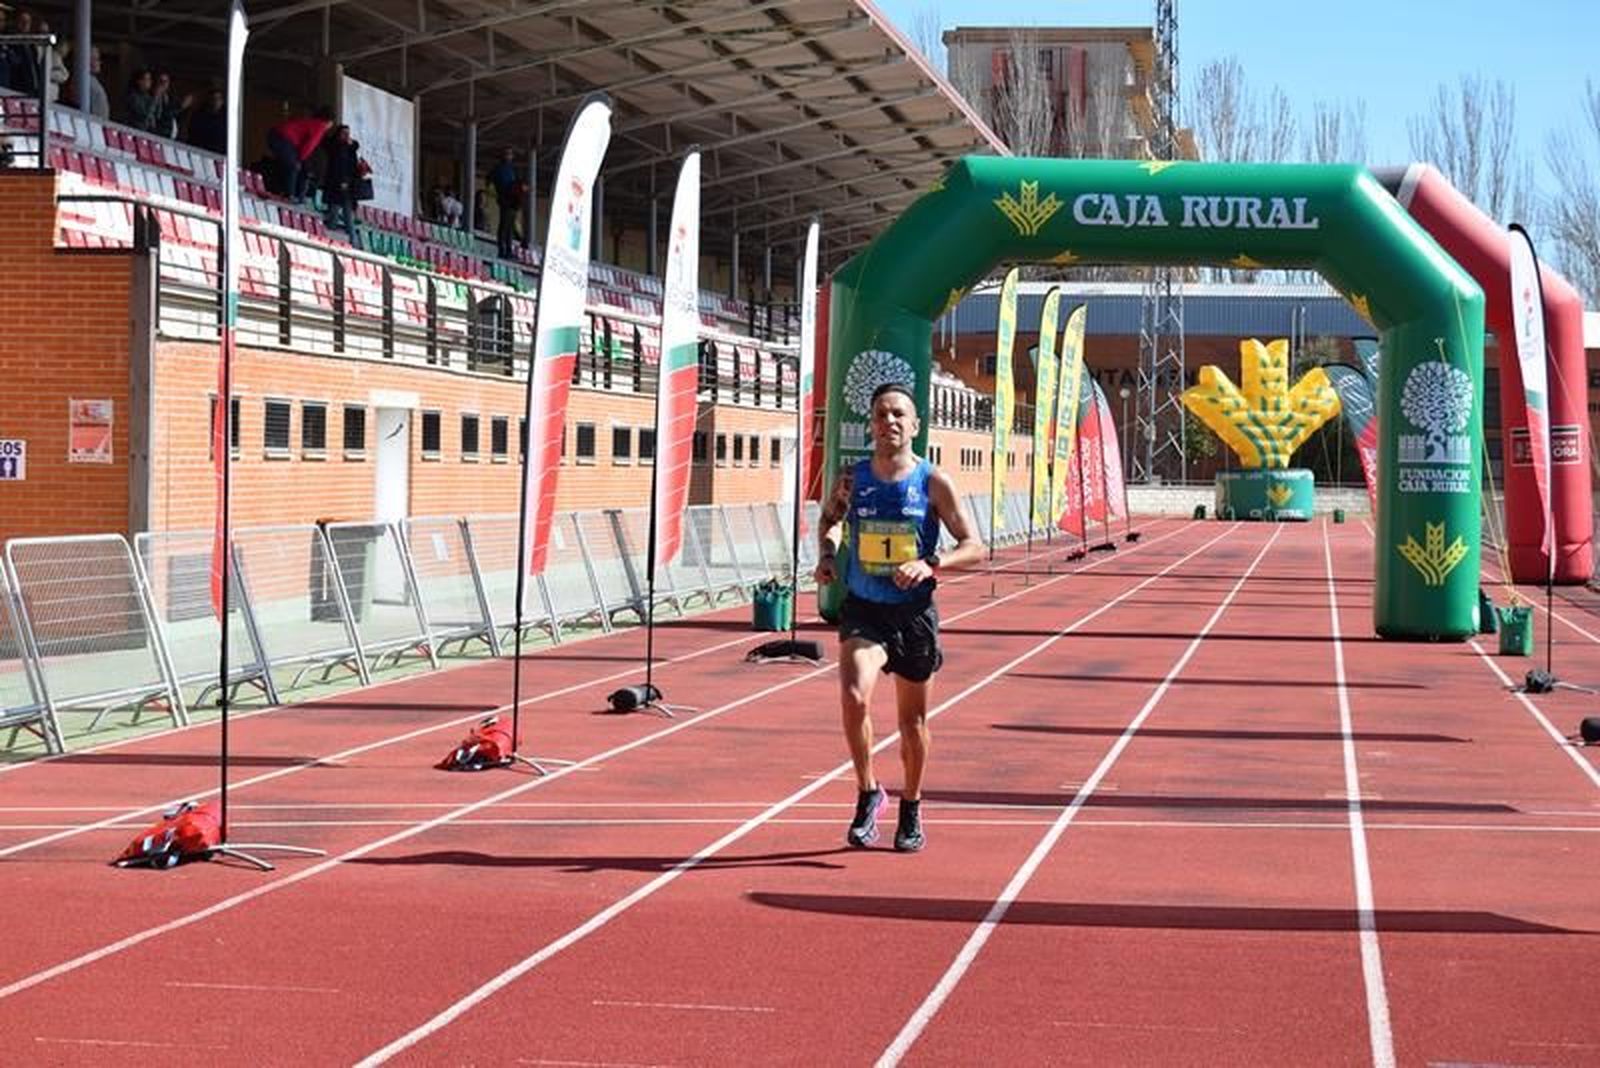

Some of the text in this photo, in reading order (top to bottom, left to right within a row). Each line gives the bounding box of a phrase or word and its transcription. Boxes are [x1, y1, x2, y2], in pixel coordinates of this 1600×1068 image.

[1073, 193, 1319, 229] CAJA RURAL
[1398, 480, 1471, 494] CAJA RURAL
[881, 537, 891, 560] 1
